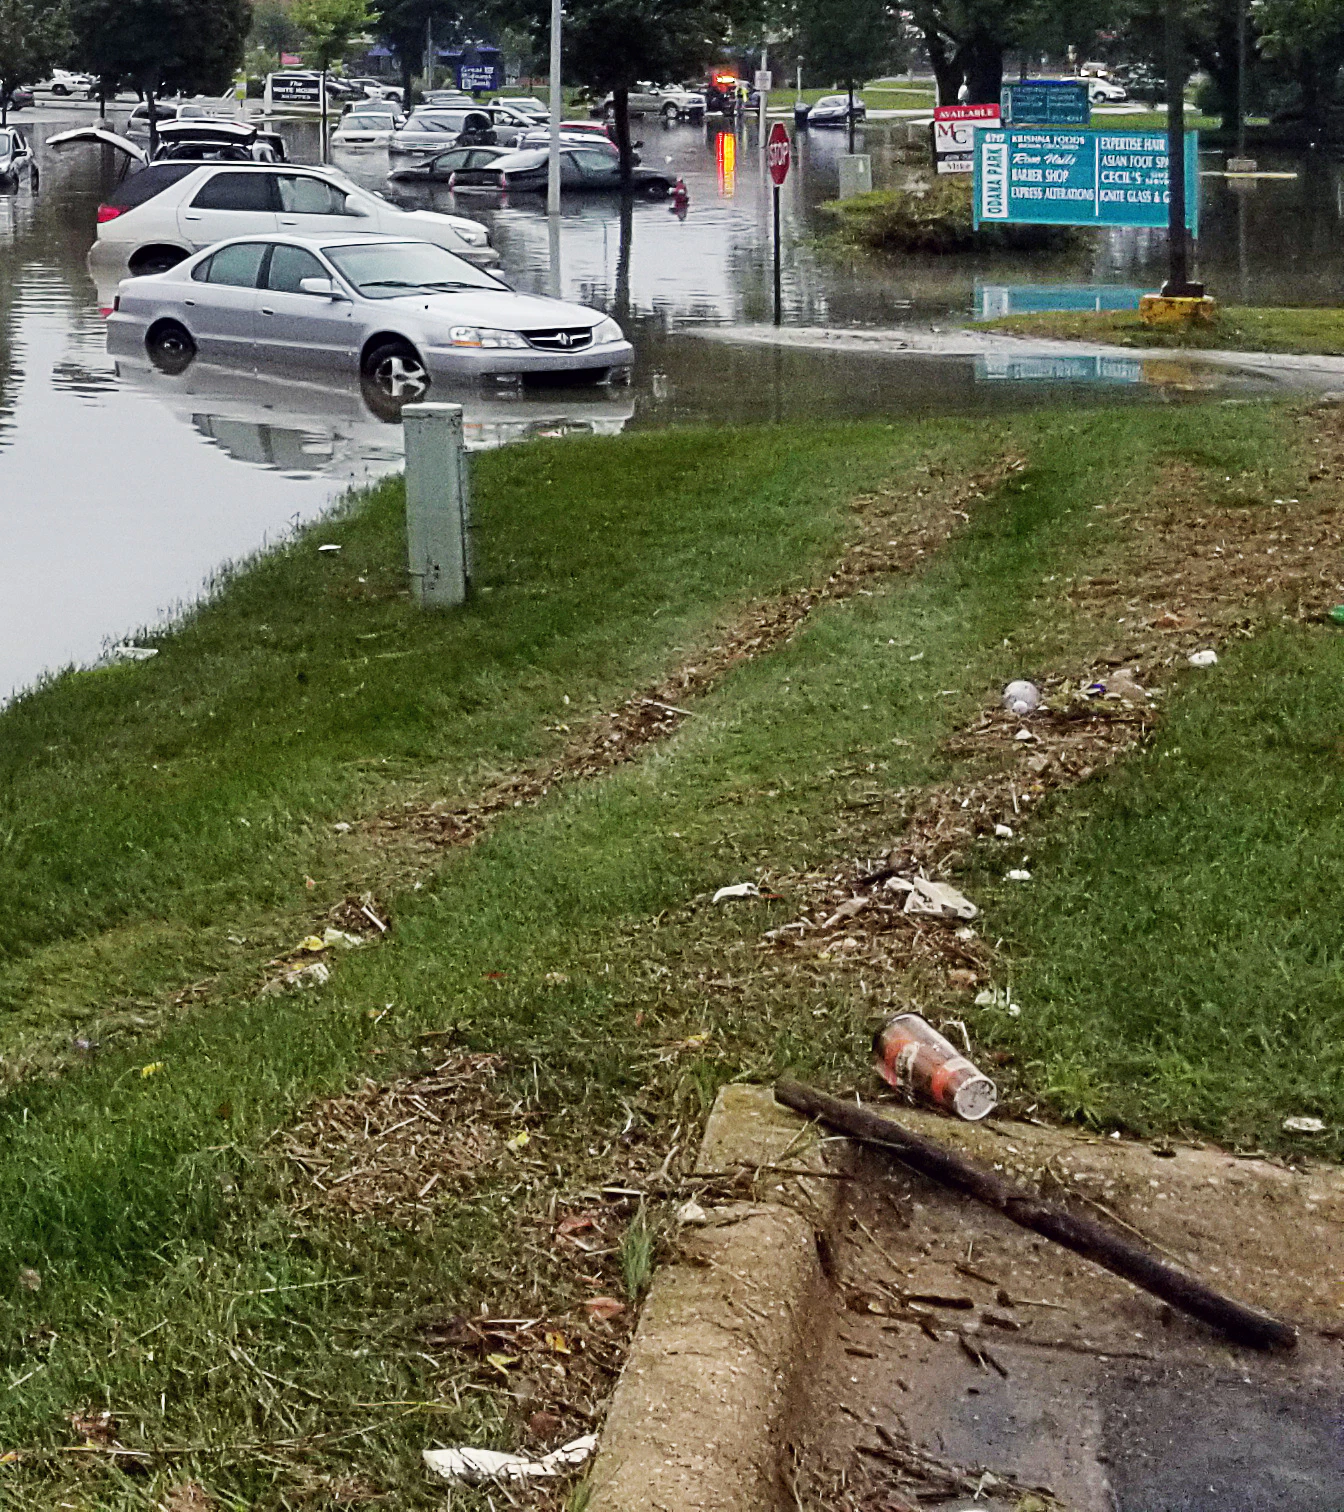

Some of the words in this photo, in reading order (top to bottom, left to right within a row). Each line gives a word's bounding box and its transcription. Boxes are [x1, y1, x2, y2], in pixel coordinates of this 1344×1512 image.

[939, 108, 994, 118] AVAILABLE
[1012, 135, 1050, 143] KRISHNA
[1053, 135, 1085, 144] FOODS
[1101, 137, 1142, 151] EXPERTISE
[1144, 138, 1165, 151] HAIR
[769, 142, 788, 166] STOP
[986, 147, 1002, 175] PARK
[1102, 155, 1127, 167] ASIAN
[1129, 155, 1153, 168] FOOT
[1012, 169, 1042, 181] BARBER
[1046, 169, 1069, 182] SHOP
[1101, 171, 1142, 184] CECIL'S
[986, 179, 1002, 214] ODANA
[1012, 187, 1043, 199] EXPRESS
[1045, 187, 1094, 201] ALTERATIONS
[1100, 190, 1125, 202] IGNITE
[1127, 190, 1152, 203] GLASS
